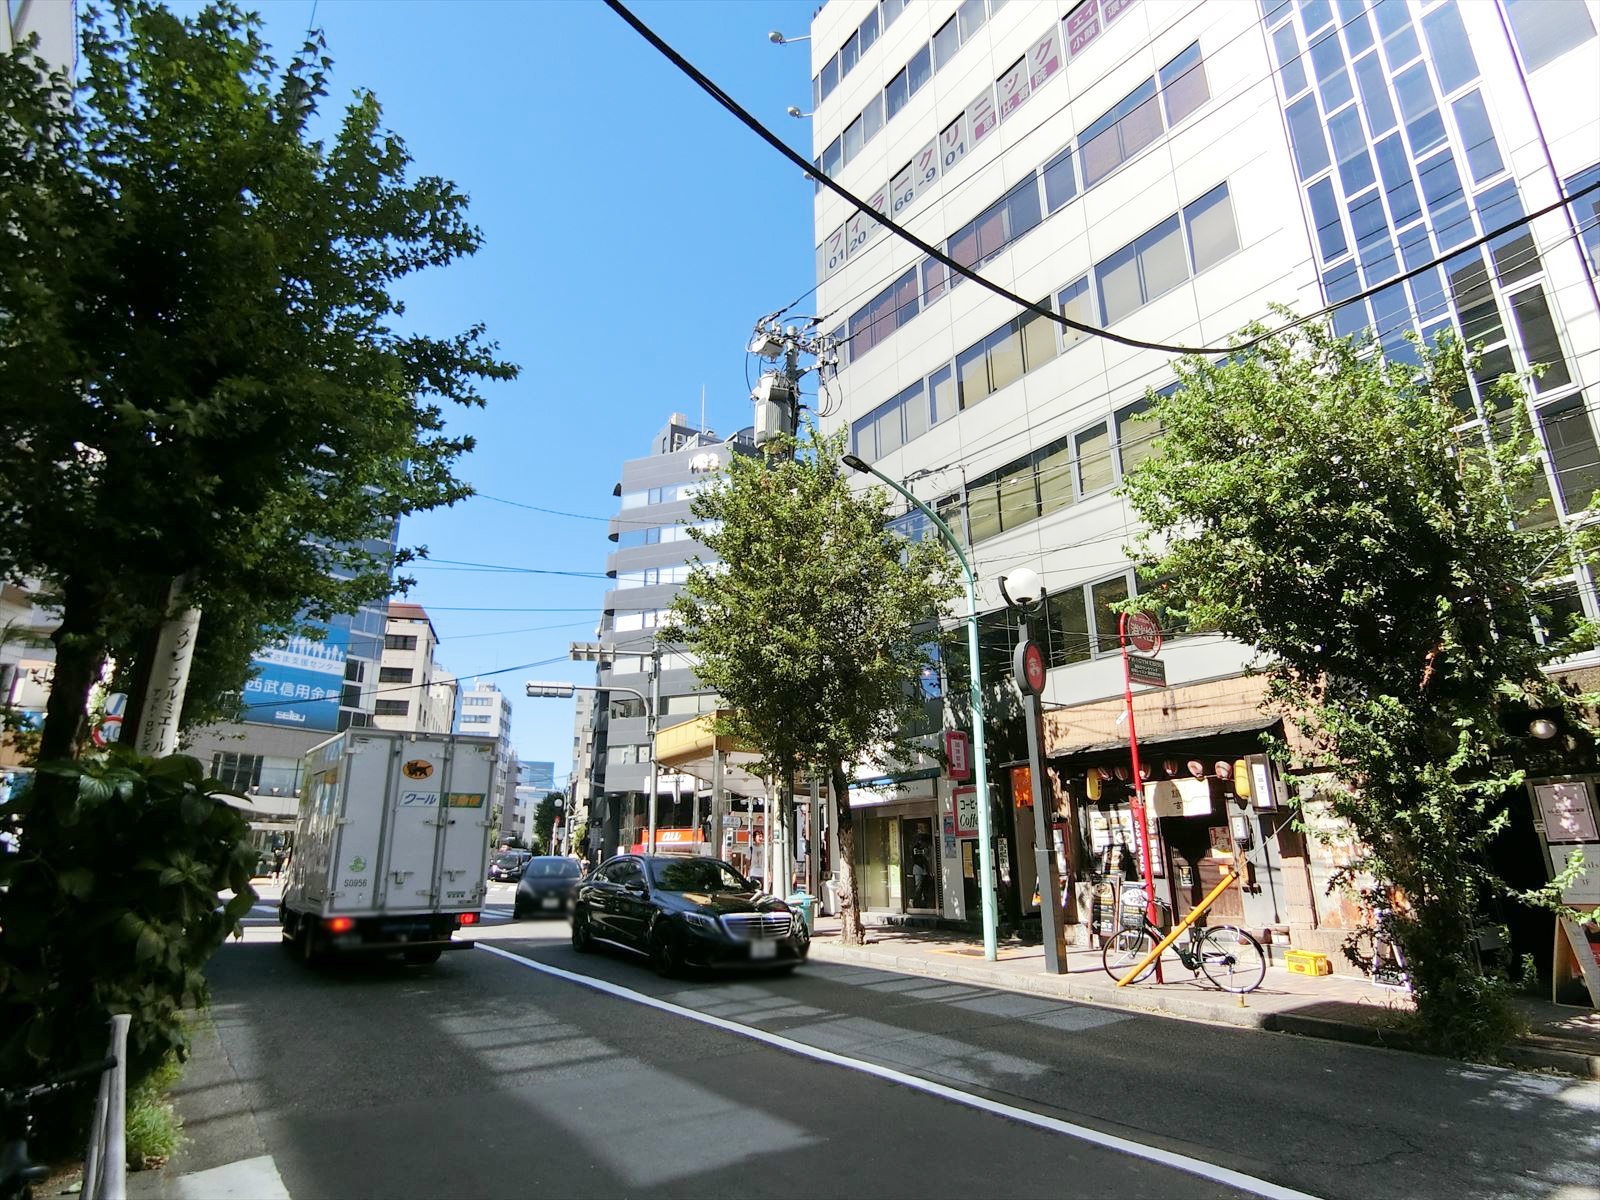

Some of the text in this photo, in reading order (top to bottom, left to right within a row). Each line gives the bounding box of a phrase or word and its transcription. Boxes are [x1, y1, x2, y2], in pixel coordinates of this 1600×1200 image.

[245, 678, 341, 703] 西武信用金庫
[404, 793, 437, 805] クール
[960, 799, 978, 811] コーヒ
[661, 831, 682, 842] au
